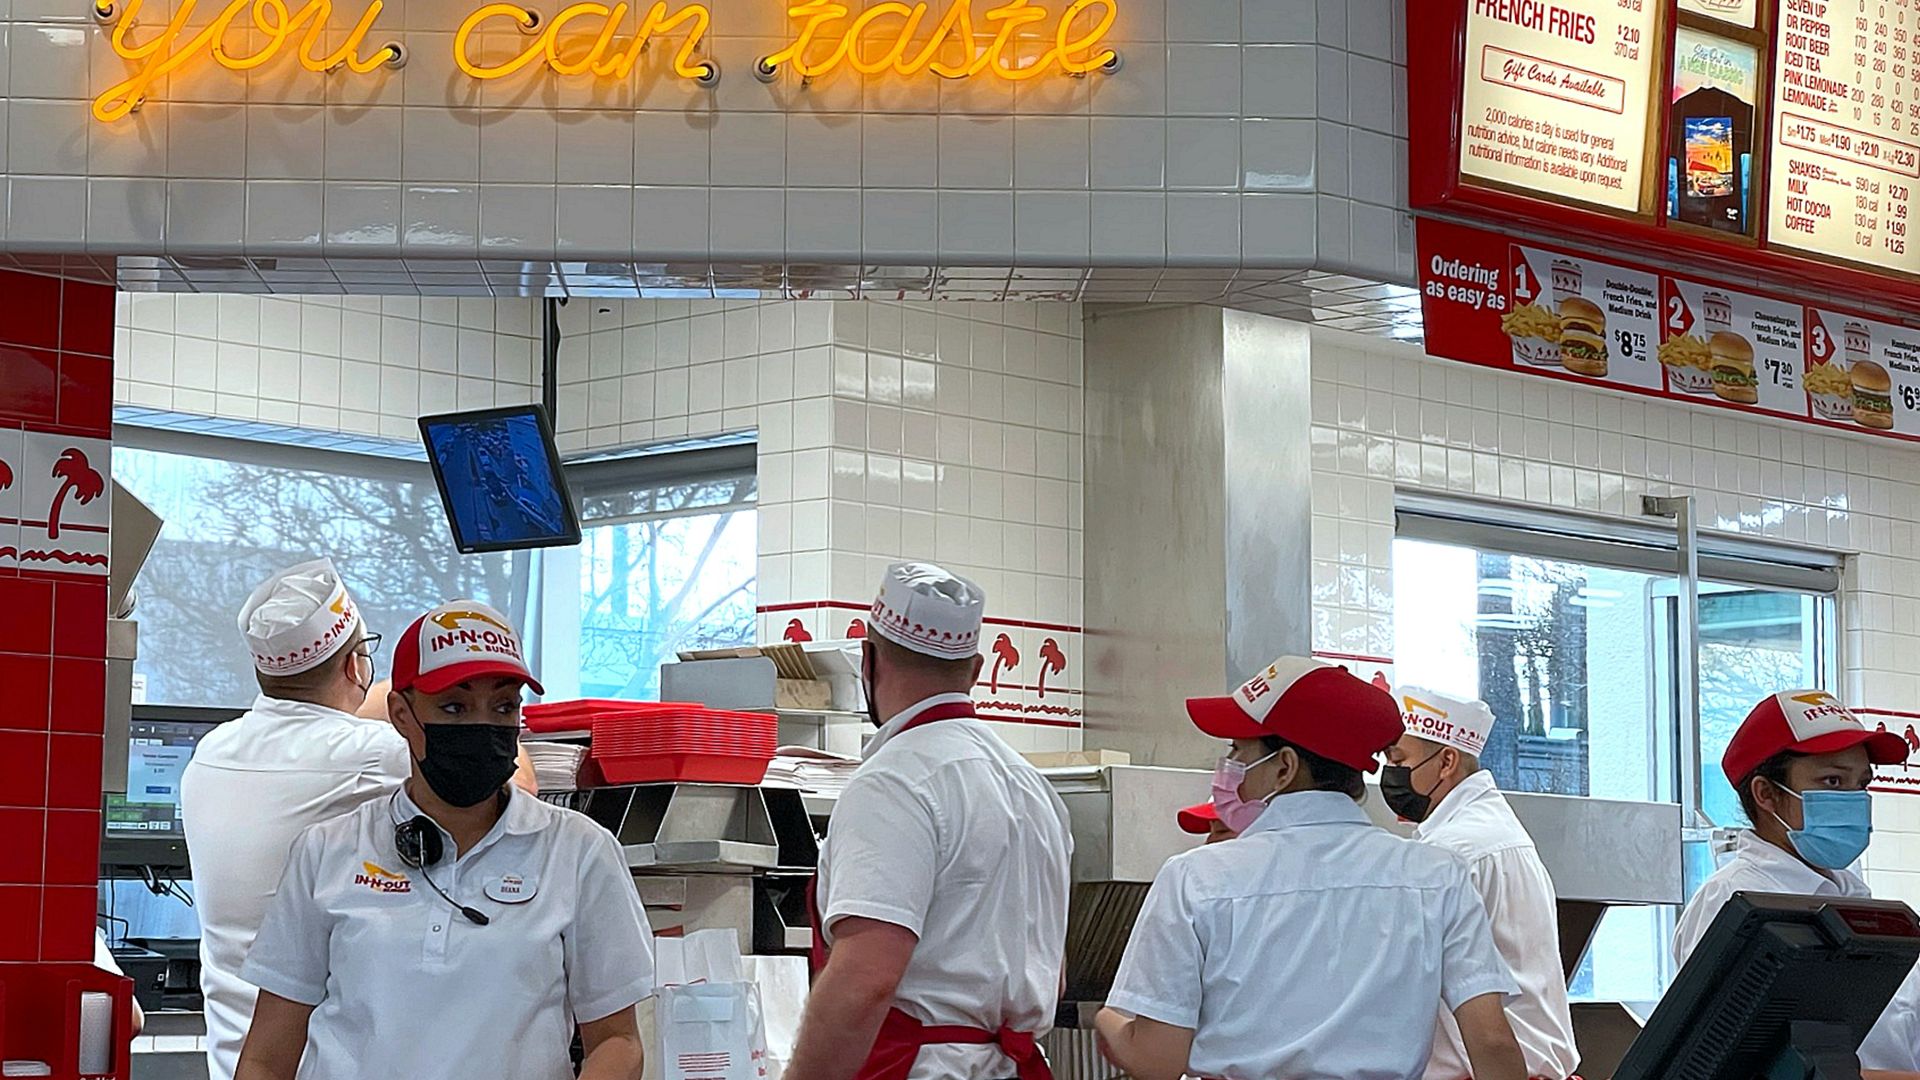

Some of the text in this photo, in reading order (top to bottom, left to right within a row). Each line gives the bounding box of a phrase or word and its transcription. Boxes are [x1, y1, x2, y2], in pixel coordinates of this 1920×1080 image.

[1476, 0, 1544, 31] FRENCH
[1549, 7, 1595, 44] FRIES
[1787, 0, 1813, 15] SEVEN
[1816, 2, 1827, 18] UP
[1856, 17, 1868, 31] 160
[1875, 22, 1888, 37] 240
[1879, 5, 1884, 18] 0
[1898, 11, 1904, 24] 0
[1614, 42, 1639, 60] 370 cal
[1786, 32, 1807, 50] ROOT
[1810, 38, 1830, 56] BEER
[1854, 52, 1866, 67] 190
[1787, 14, 1798, 30] DR
[1800, 18, 1831, 39] PEPPER
[1855, 35, 1867, 49] 170
[1874, 40, 1887, 55] 240
[92, 0, 1115, 122] you can taste
[1785, 50, 1919, 100] ICED TEA 0 0 0 0
[1503, 59, 1605, 98] Gift Cards Available
[1784, 68, 1803, 87] PINK
[1805, 74, 1848, 98] LEMONADE
[1851, 88, 1865, 104] 200
[1782, 86, 1827, 111] LEMONADE
[1854, 107, 1861, 121] 10
[1873, 112, 1881, 126] 15
[1892, 117, 1900, 131] 20
[1911, 122, 1920, 136] 25
[1486, 107, 1615, 150] 2,000 calories a day is used for general
[1468, 124, 1496, 141] nutrition
[1498, 130, 1520, 149] advice,
[1523, 135, 1534, 151] but
[1536, 139, 1557, 156] calorie
[1559, 146, 1578, 161] needs
[1597, 152, 1628, 172] Additional
[1797, 124, 1816, 142] $1.75
[1831, 132, 1851, 151] $1.90
[1861, 141, 1879, 158] $2.10
[1895, 149, 1915, 168] $2.30
[1469, 144, 1623, 189] nutritional information is available upon request.
[1789, 160, 1821, 180] SHAKES
[1856, 177, 1869, 192] 590
[1870, 182, 1880, 194] cal
[1889, 184, 1908, 201] $2.70
[1788, 178, 1808, 196] MILK
[1869, 200, 1878, 212] cal
[1787, 196, 1803, 212] HOT
[1805, 200, 1831, 219] COCOA
[1868, 218, 1877, 230] cal
[1786, 215, 1815, 234] COFFEE
[1856, 232, 1861, 245] 0
[1862, 234, 1873, 247] cal
[1431, 255, 1499, 291] Ordering
[1515, 264, 1531, 299] 1
[1426, 280, 1506, 310] as easy as
[1603, 290, 1657, 310] French Fries, and
[1608, 303, 1652, 320] Medium Drink
[1669, 296, 1684, 329] 2
[1755, 312, 1798, 328] Cheeseburger,
[1751, 321, 1801, 339] French Fries, and
[1757, 334, 1797, 349] Medium Drink
[1812, 326, 1827, 357] 3
[1884, 348, 1902, 359] French
[1889, 360, 1911, 371] Medium
[431, 630, 516, 652] IN-N-OUT
[355, 874, 411, 888] IN-N-OUT
